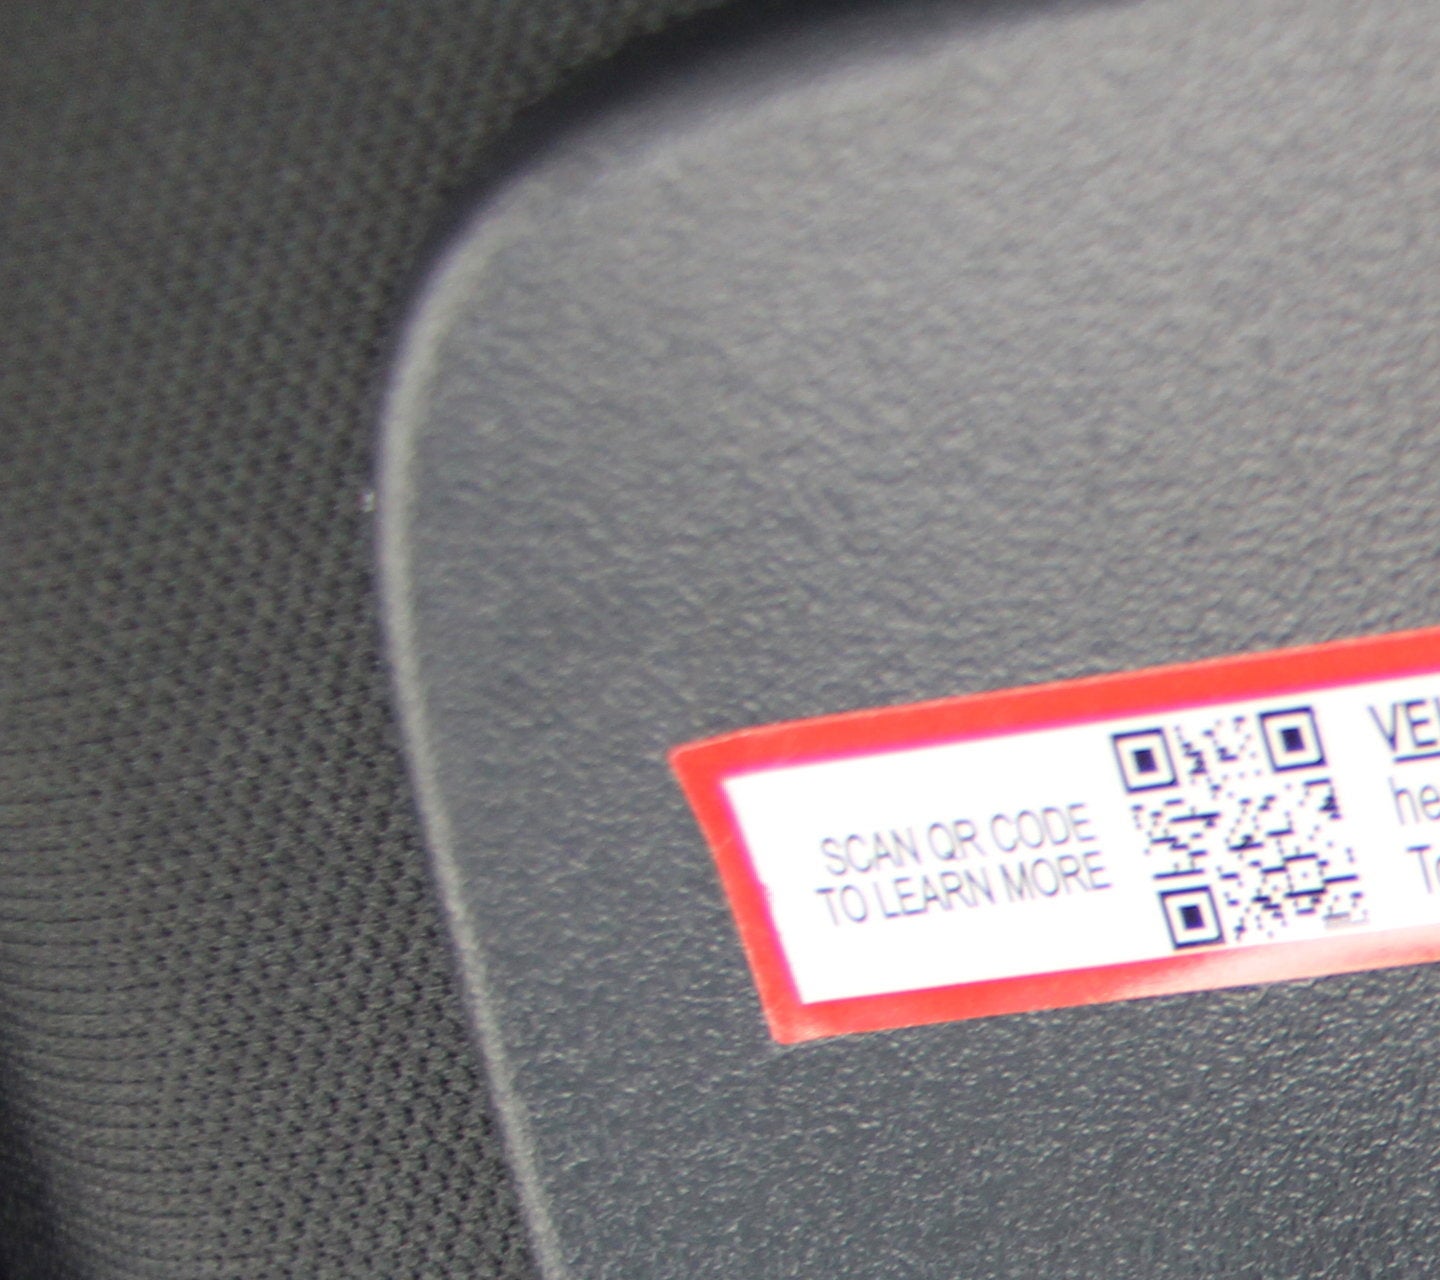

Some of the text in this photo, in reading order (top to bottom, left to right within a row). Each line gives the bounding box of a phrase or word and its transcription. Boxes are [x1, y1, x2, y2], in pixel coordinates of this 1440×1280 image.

[819, 803, 1096, 877] SCAN QR CODE
[815, 851, 1111, 926] TO LEARN MORE
